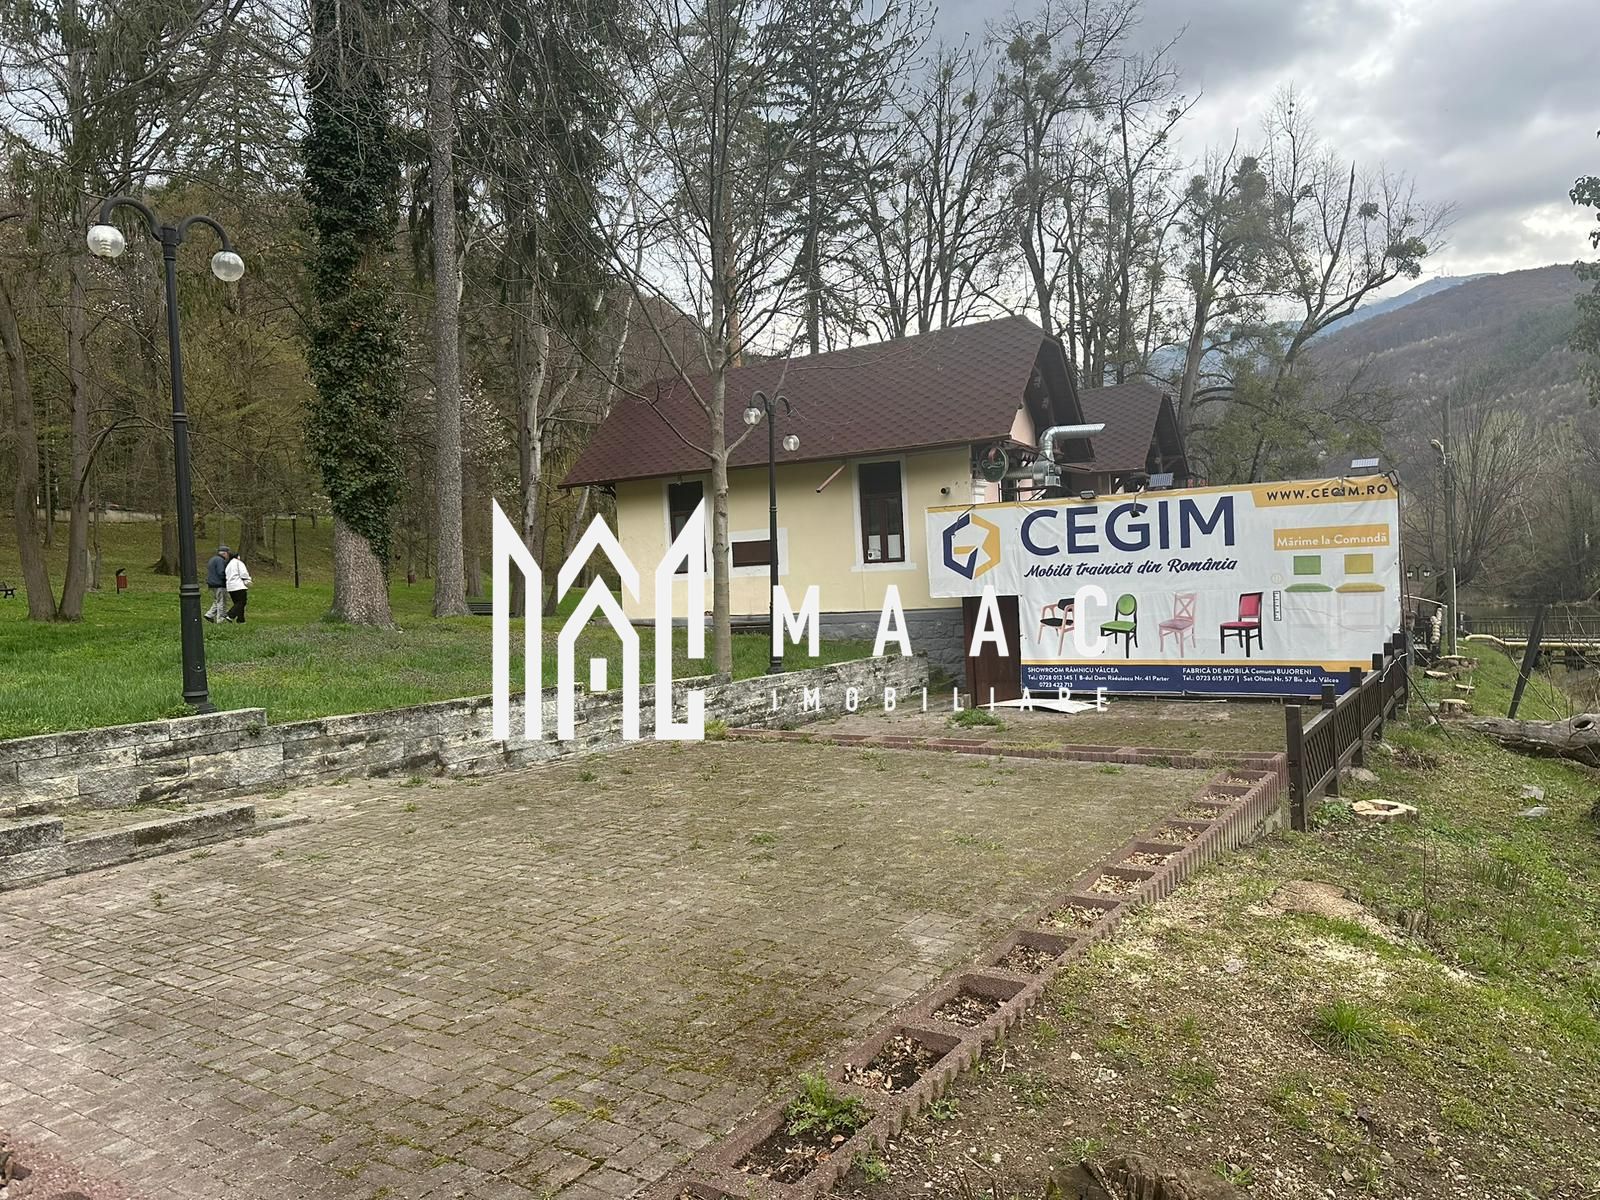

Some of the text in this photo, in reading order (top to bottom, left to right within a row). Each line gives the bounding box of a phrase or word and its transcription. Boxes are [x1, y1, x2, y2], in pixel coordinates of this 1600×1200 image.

[1020, 495, 1235, 557] CEGIM
[1276, 532, 1387, 547] Mărime la Comandă
[1023, 557, 1238, 578] Mobilă trainică din România
